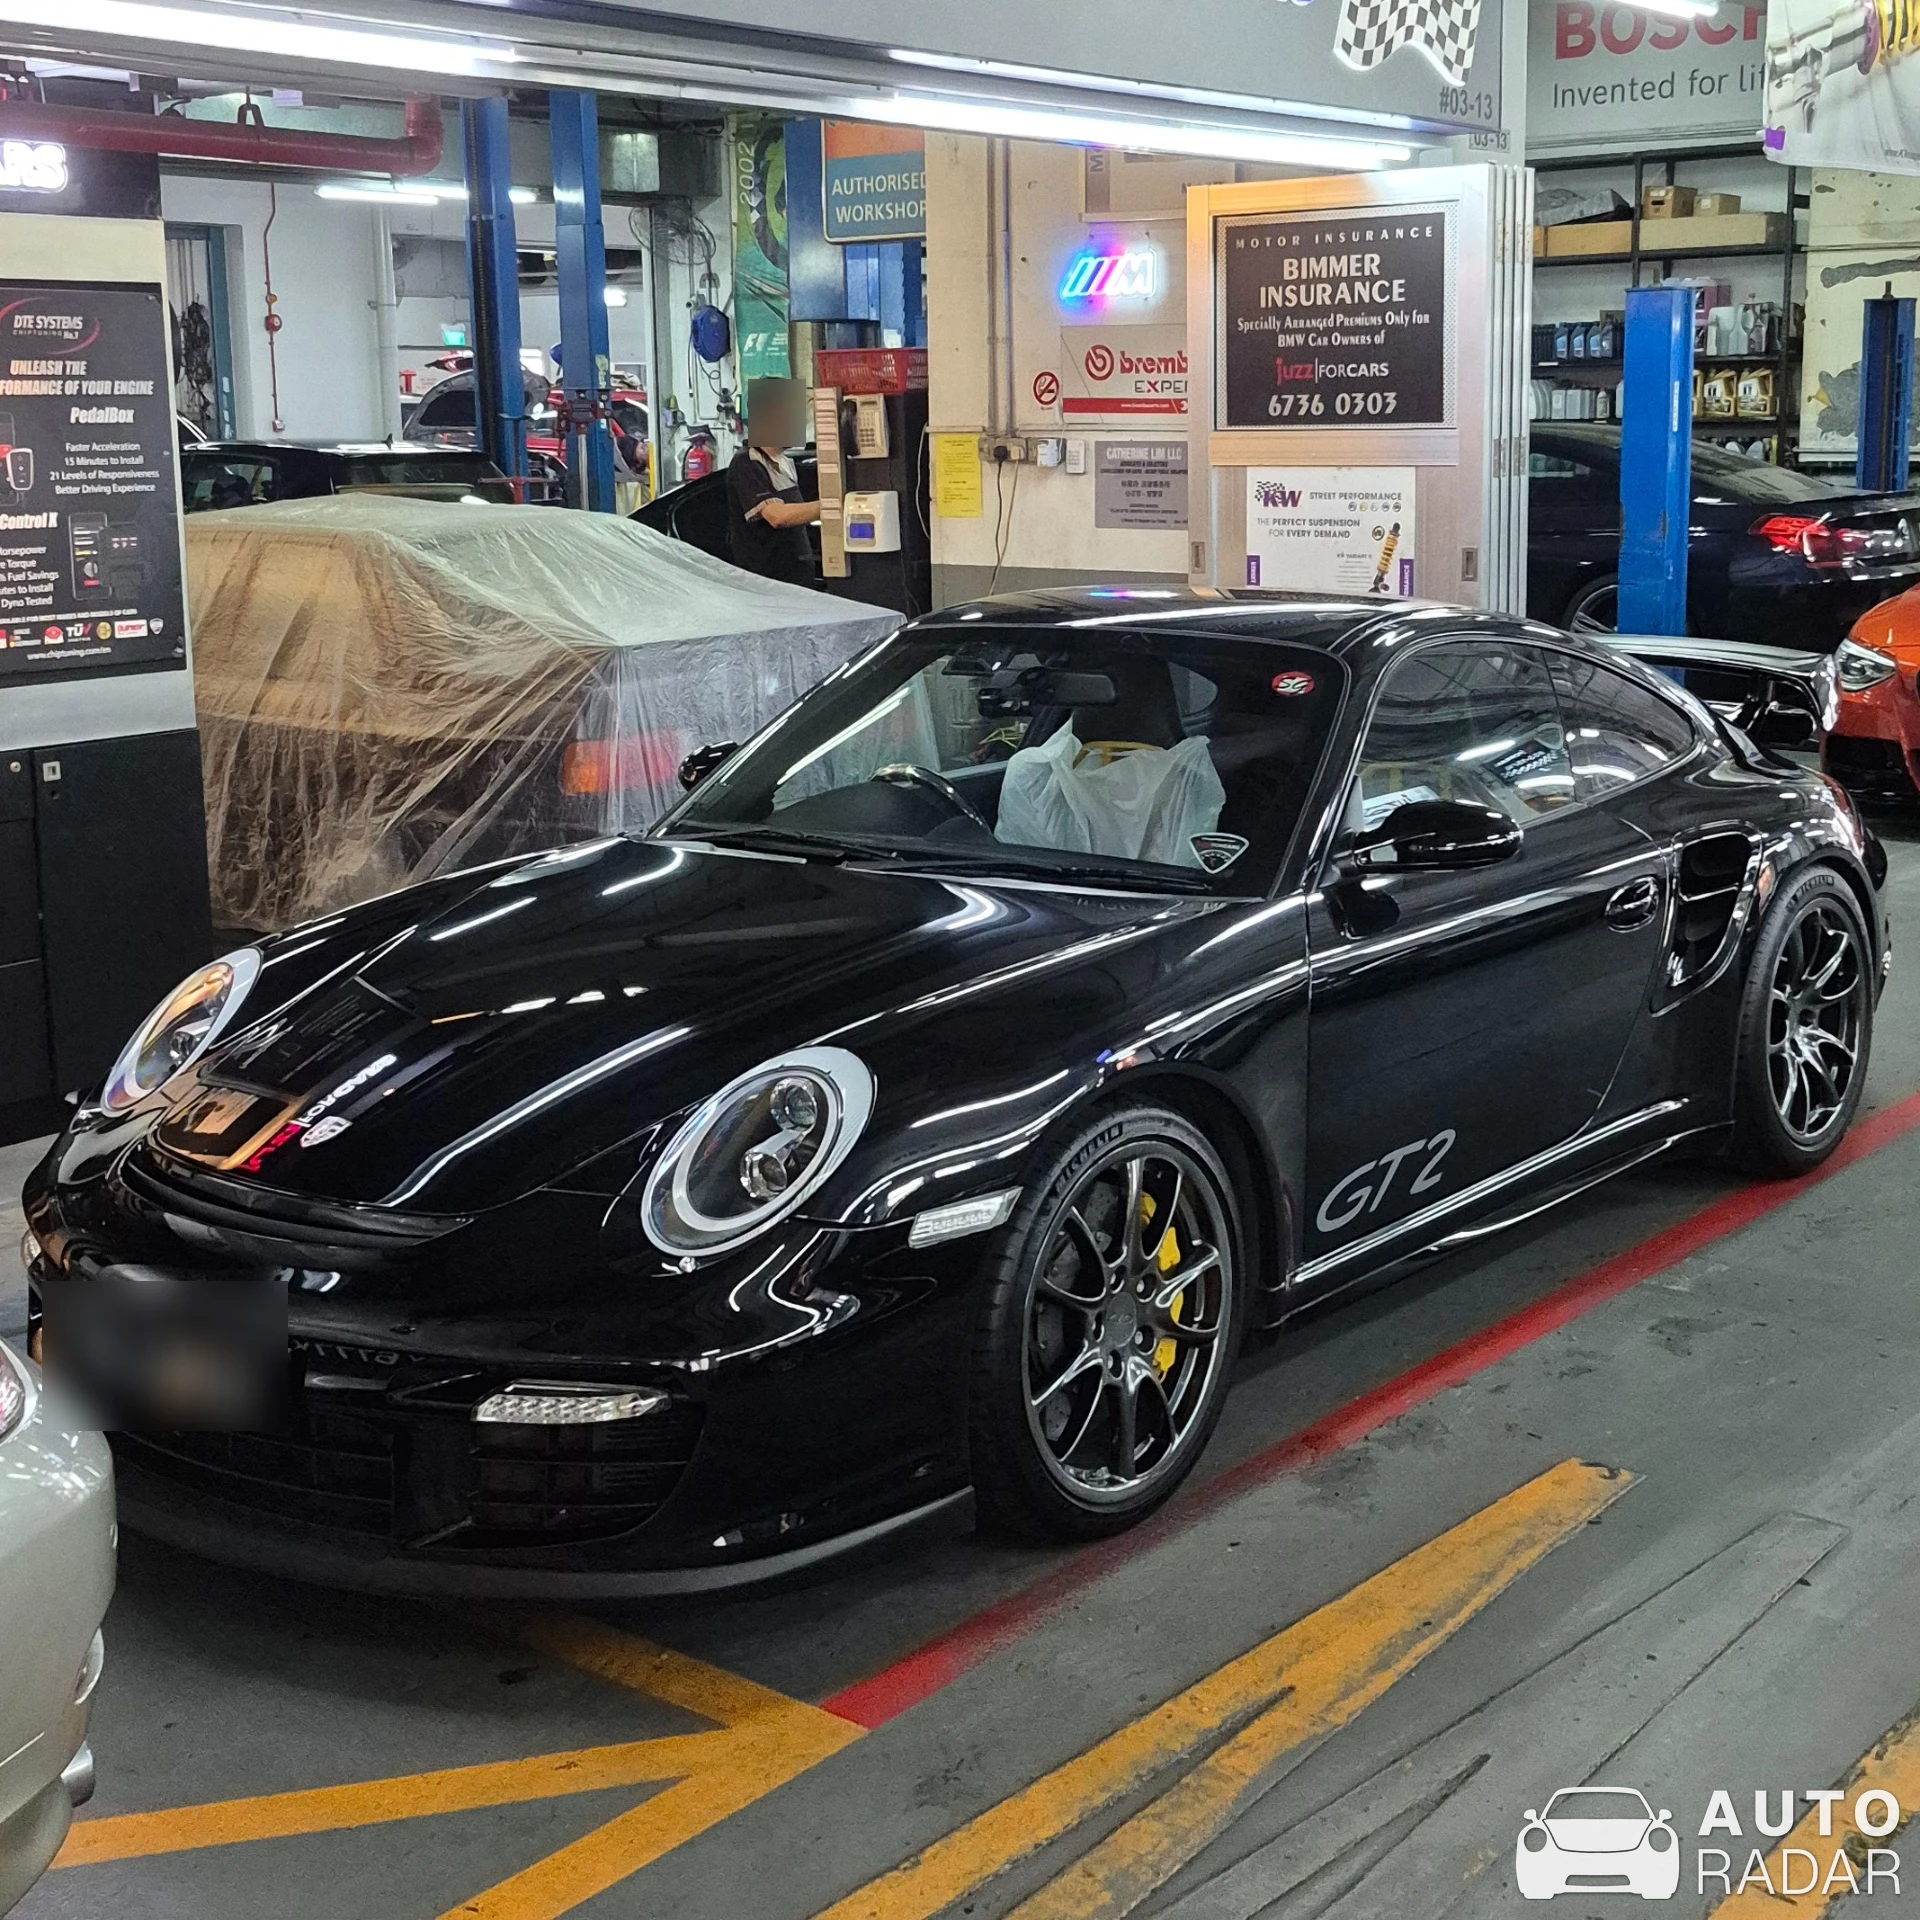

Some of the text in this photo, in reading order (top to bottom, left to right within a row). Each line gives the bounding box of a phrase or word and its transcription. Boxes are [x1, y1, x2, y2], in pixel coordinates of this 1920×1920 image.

[1554, 63, 1765, 108] Invented for lif
[1440, 85, 1493, 120] #03-13
[1474, 132, 1507, 149] 03-13
[738, 141, 756, 206] 2002
[1236, 226, 1433, 249] MOTOR INSURANCE
[1283, 253, 1381, 281] BIMMER
[1259, 279, 1406, 309] INSURANCE
[13, 315, 83, 330] DTE SYSTEMS
[1278, 334, 1304, 349] BMW
[1374, 330, 1386, 345] of
[10, 360, 87, 376] UNLEASH THE
[1119, 350, 1188, 375] bremb
[64, 380, 80, 396] OF
[81, 380, 113, 396] YOUR
[114, 381, 154, 396] ENGINE
[1134, 380, 1188, 393] EXPE
[1268, 391, 1398, 417] 6736 0303
[70, 406, 135, 424] PedalBox
[65, 443, 141, 452] Faster Acceleration
[1106, 447, 1183, 460] CATHERINE LIM LLC
[65, 456, 144, 466] 15 Minutes to Install
[50, 470, 160, 481] 21 Levels of Responsiveness
[55, 484, 156, 496] Better Driving Experience
[1309, 492, 1402, 501] STREET PERFORMANCE
[1257, 518, 1360, 527] THE PERFECT SUSPENSION
[1269, 529, 1350, 538] FOR EVERY DEMAND
[1316, 1128, 1456, 1233] GT2
